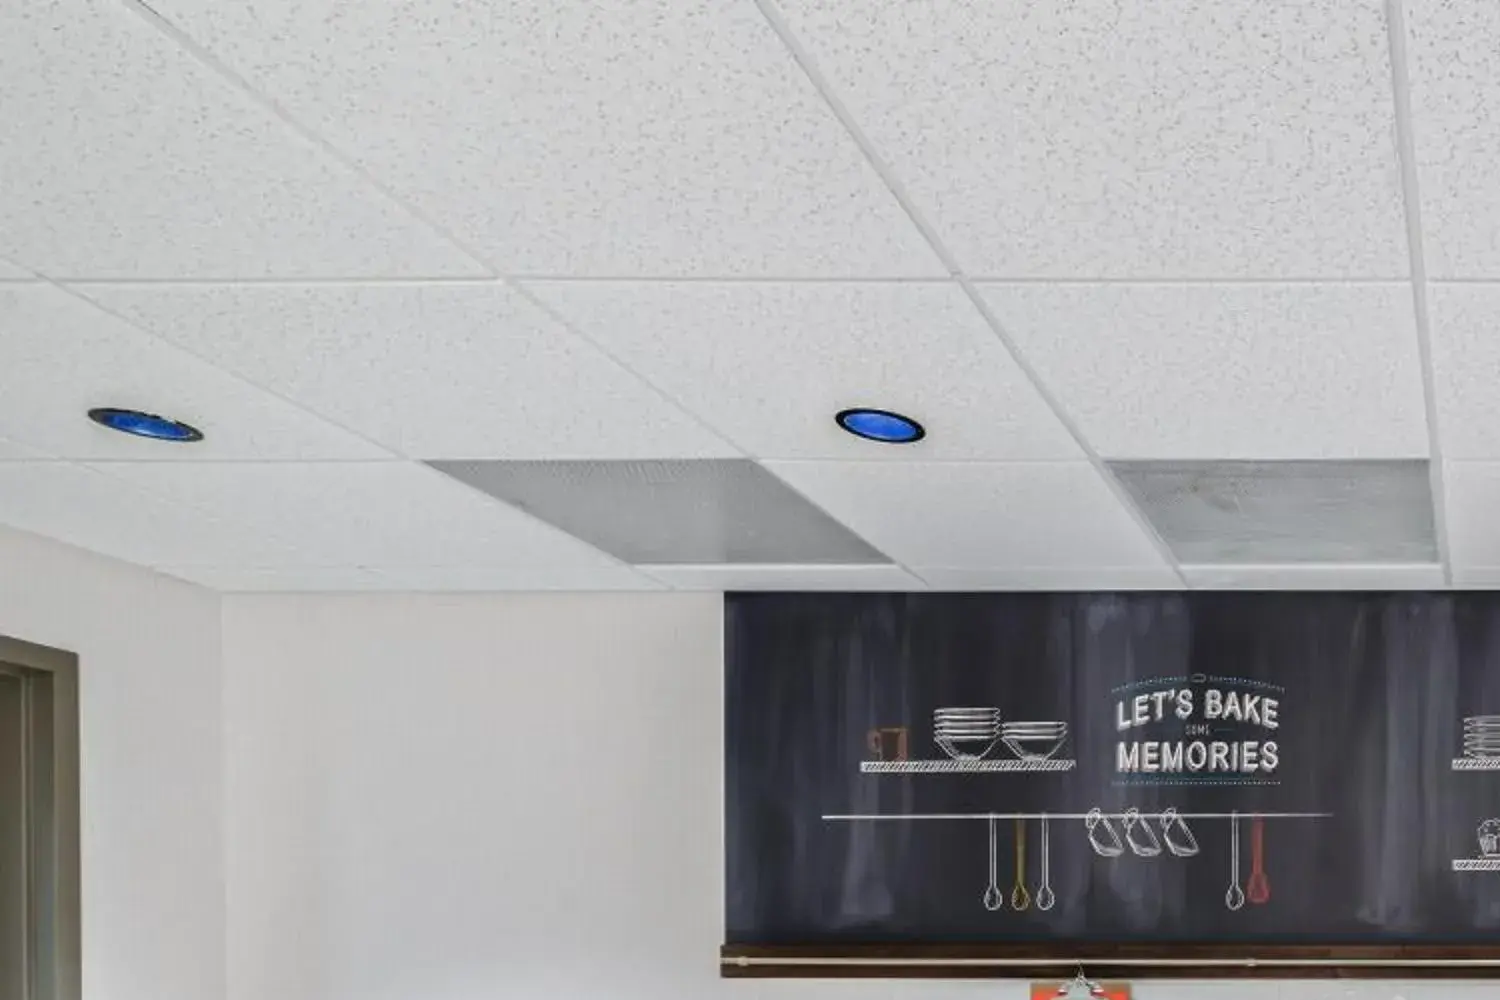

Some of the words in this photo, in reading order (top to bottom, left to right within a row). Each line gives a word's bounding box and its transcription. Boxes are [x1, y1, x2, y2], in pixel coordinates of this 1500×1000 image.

[1117, 689, 1193, 731] LET'S
[1204, 689, 1280, 729] BAKE
[1117, 741, 1278, 772] MEMORIES
